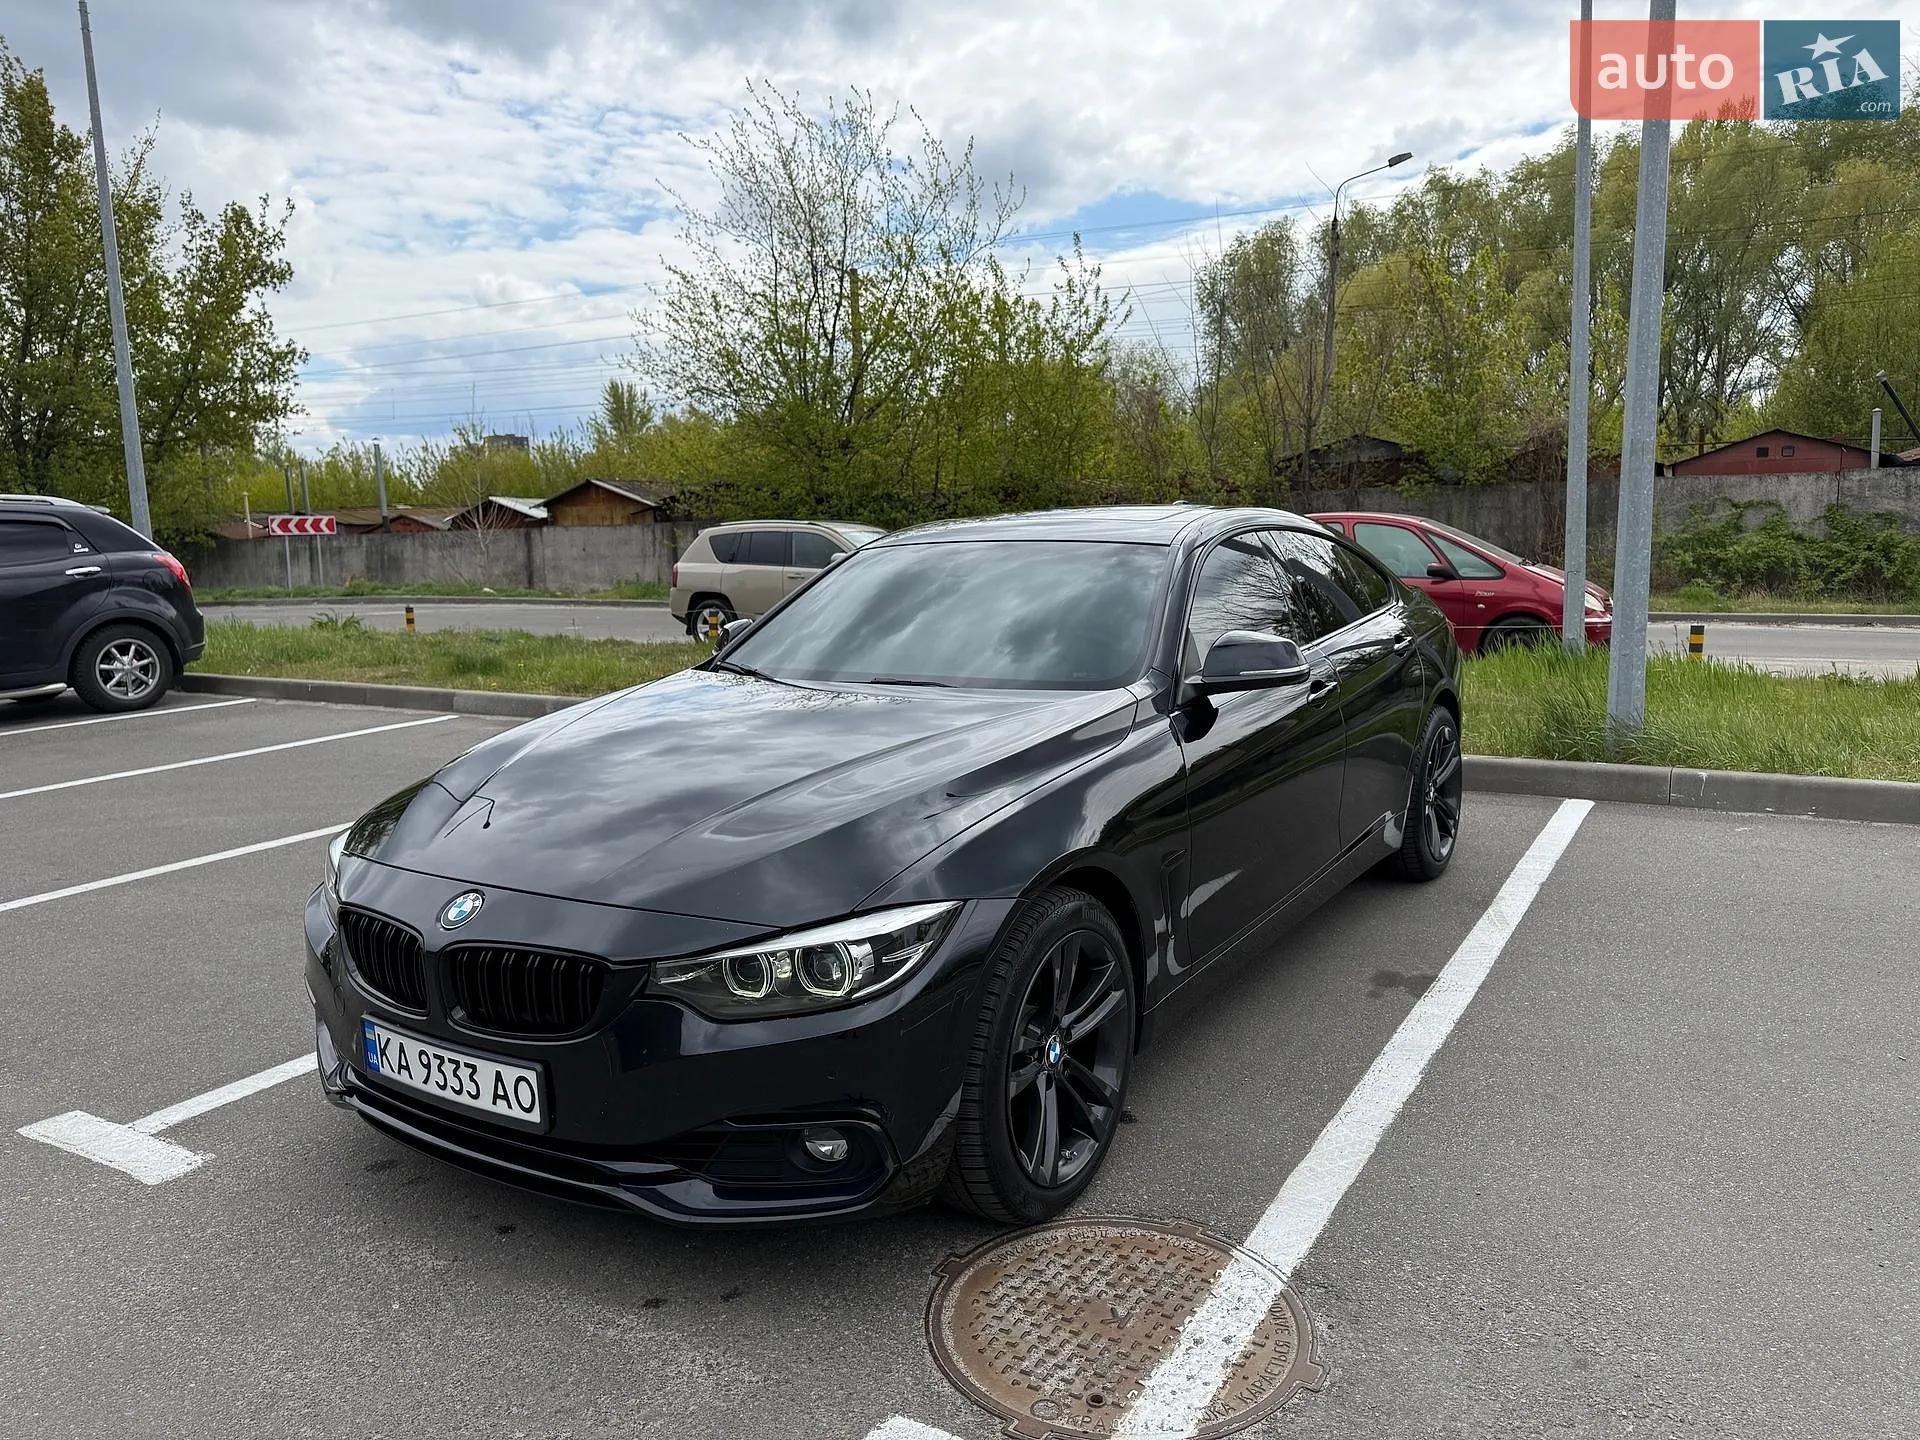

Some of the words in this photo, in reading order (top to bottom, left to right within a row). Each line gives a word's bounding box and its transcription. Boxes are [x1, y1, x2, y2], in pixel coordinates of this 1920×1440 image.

[368, 1052, 379, 1065] UA
[377, 1033, 413, 1080] KA
[418, 1049, 481, 1100] 9333
[492, 1069, 536, 1113] AO
